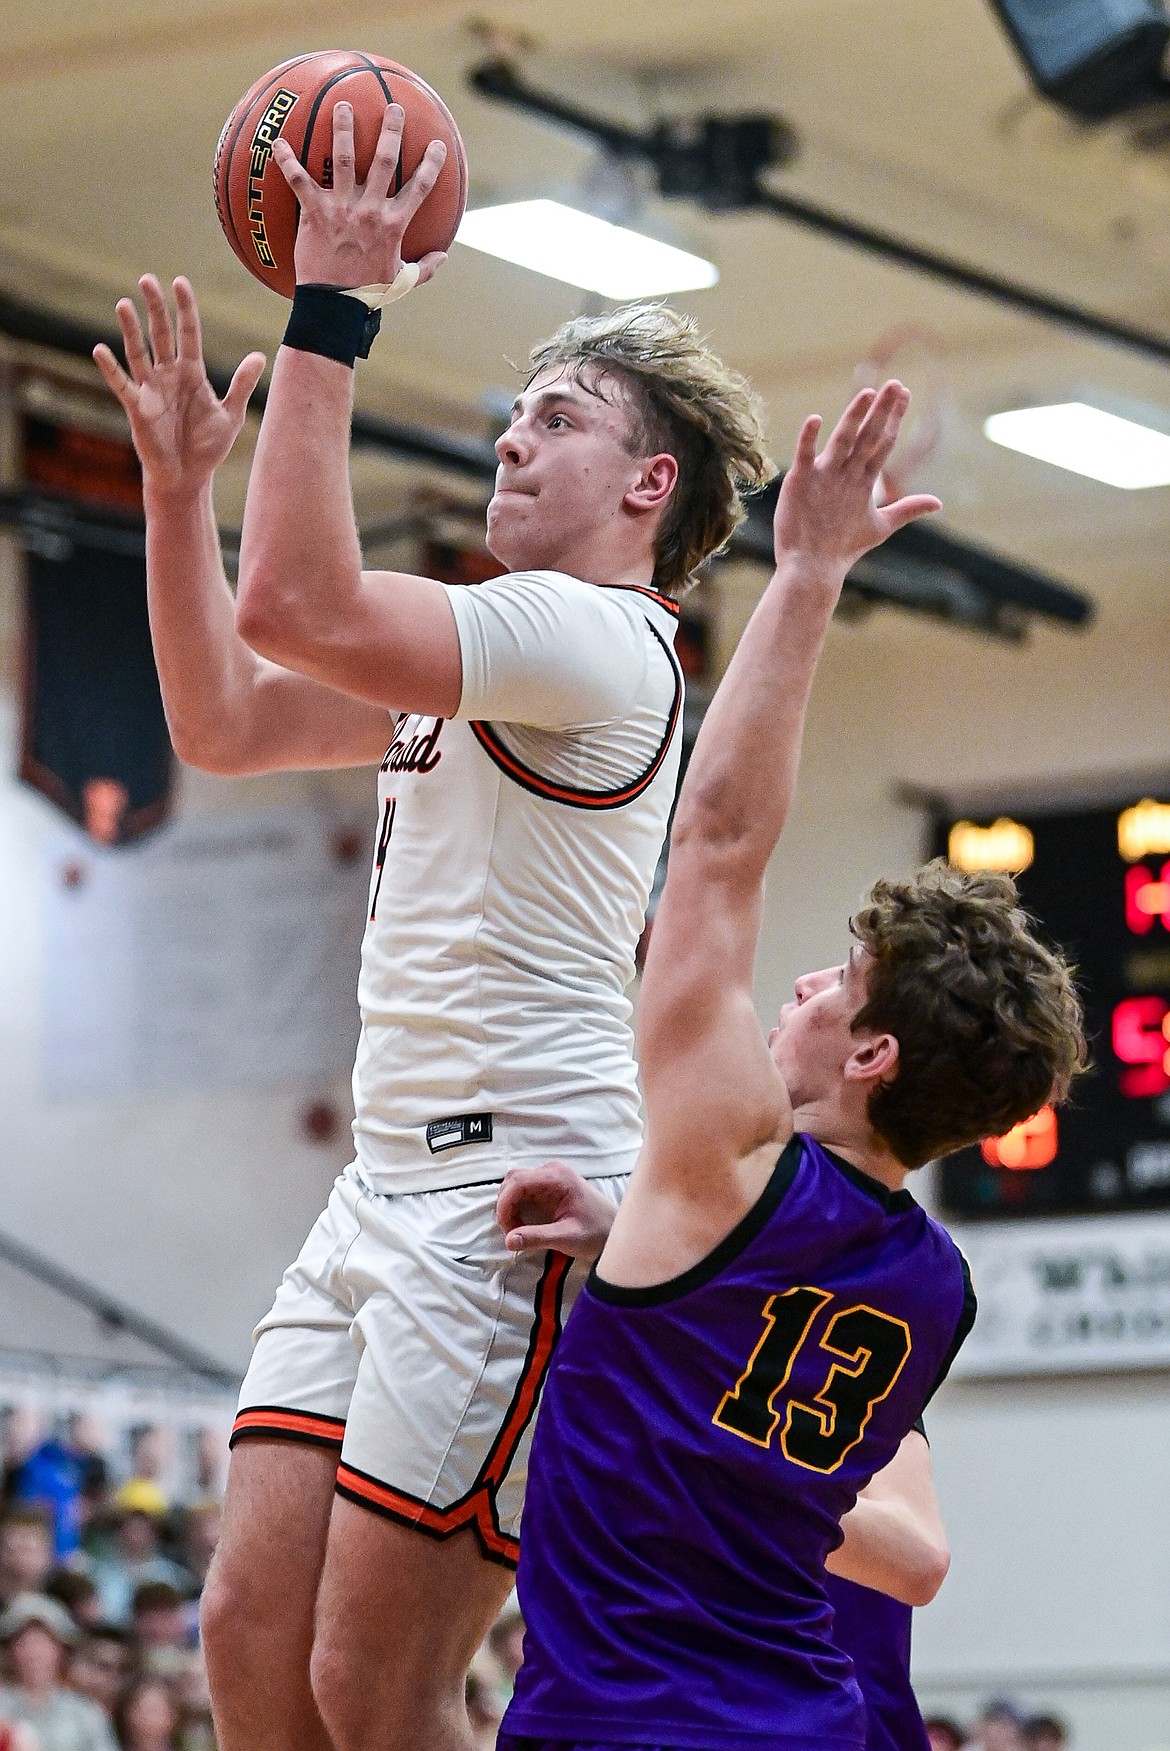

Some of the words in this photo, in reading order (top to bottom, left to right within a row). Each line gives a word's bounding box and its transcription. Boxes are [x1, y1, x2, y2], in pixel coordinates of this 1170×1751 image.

[255, 90, 296, 145] PRO
[249, 147, 278, 269] ELITE
[469, 1119, 482, 1134] M
[711, 1286, 912, 1475] 13
